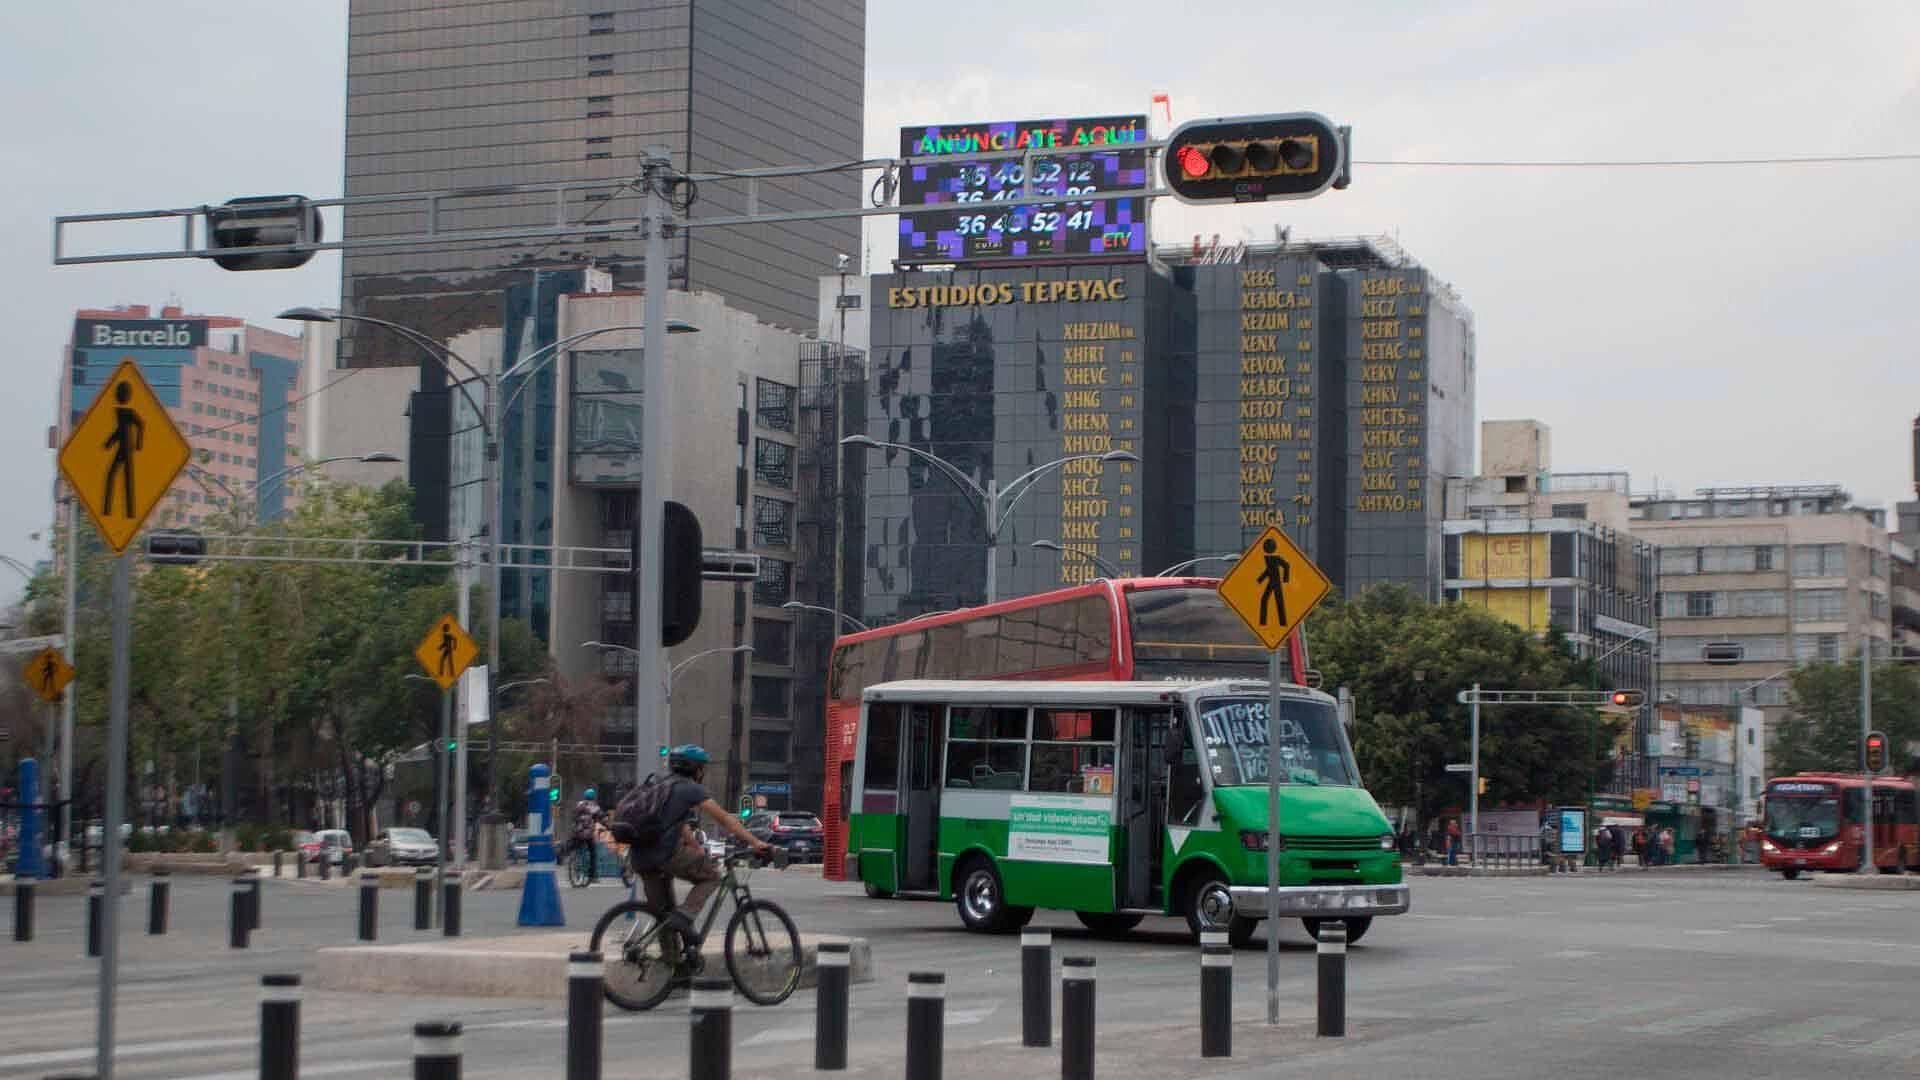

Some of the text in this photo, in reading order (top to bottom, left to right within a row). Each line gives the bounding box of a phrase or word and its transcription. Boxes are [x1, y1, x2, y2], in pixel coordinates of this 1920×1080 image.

[955, 214, 987, 235] 36
[1030, 211, 1060, 232] 52
[1066, 210, 1094, 231] 41
[887, 278, 1126, 308] ESTUDIOS TEPEYAC
[92, 324, 191, 346] Barceló
[1241, 356, 1286, 374] XEVOX
